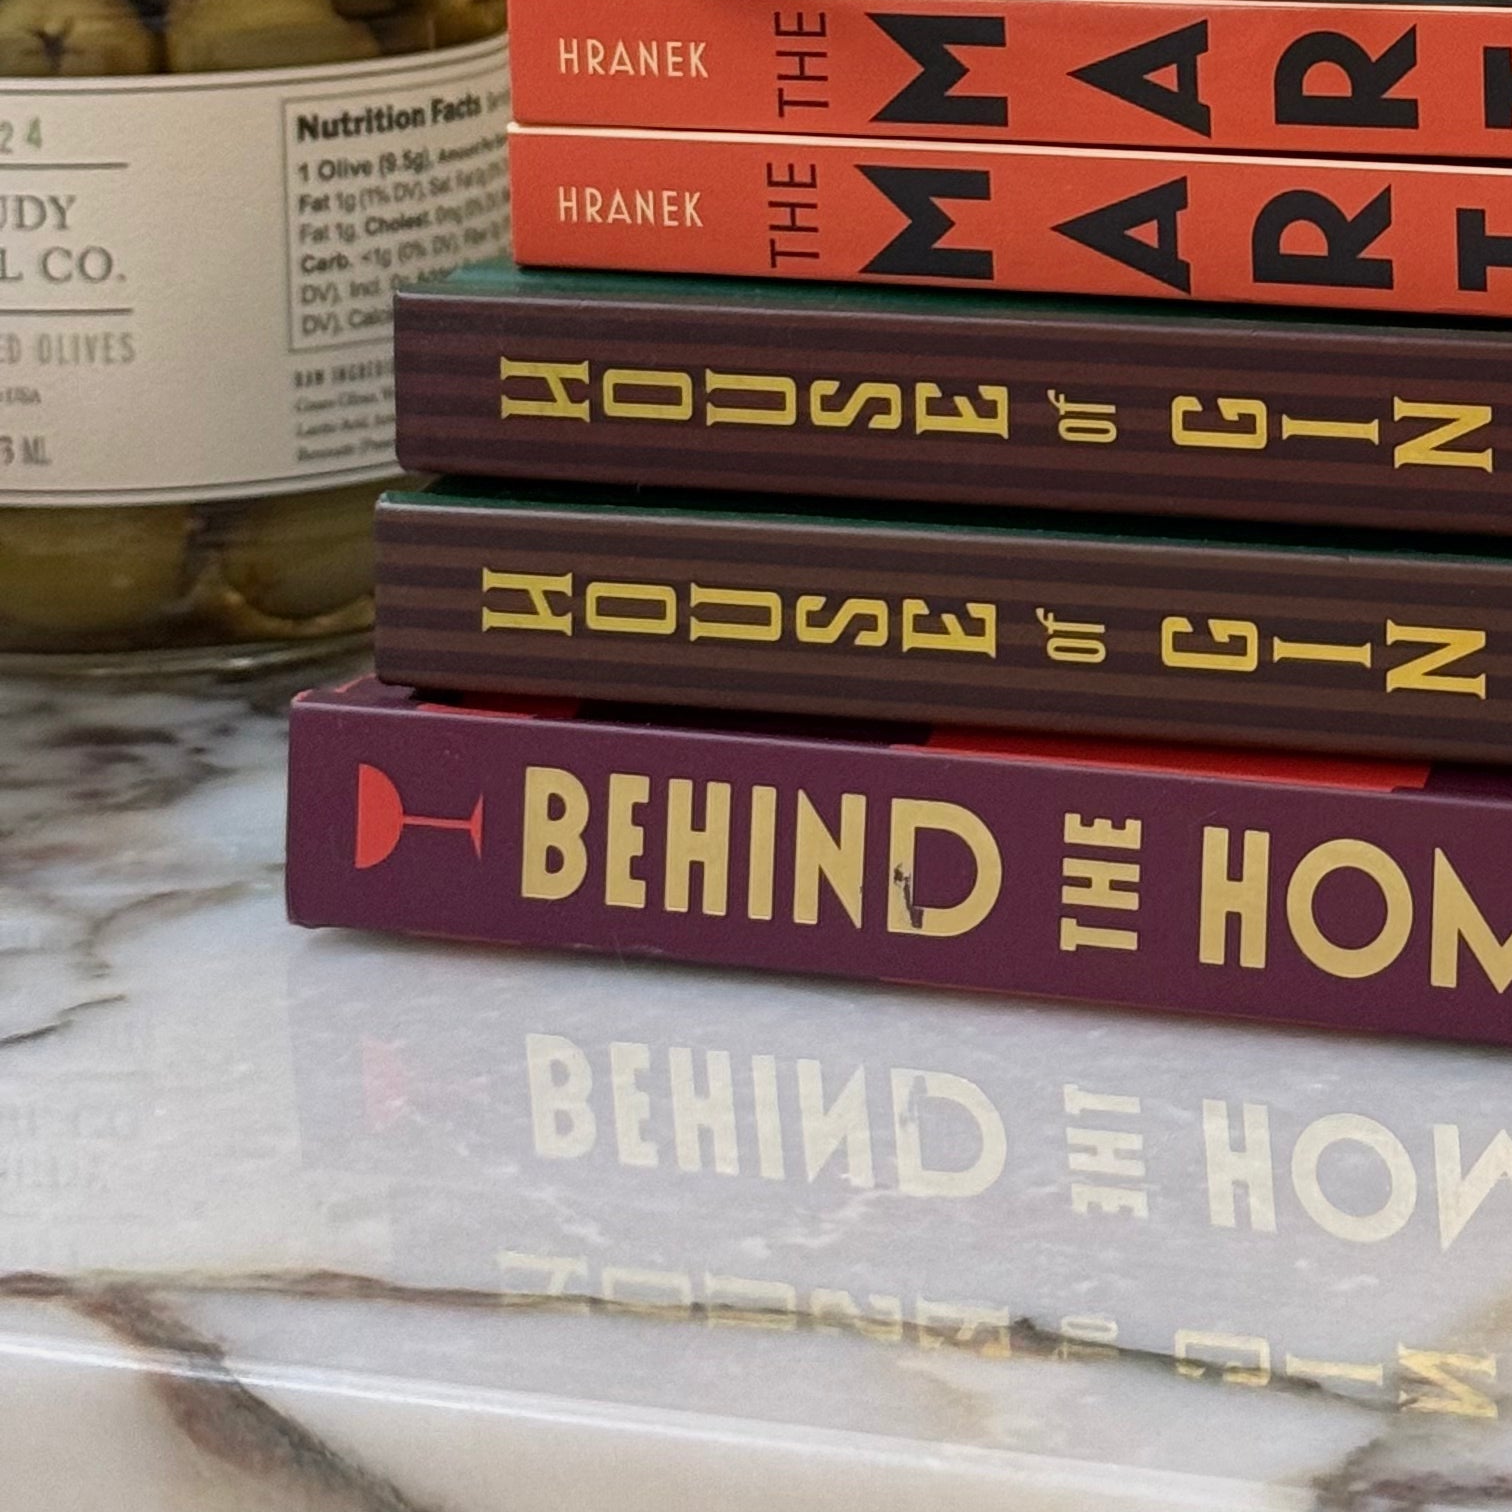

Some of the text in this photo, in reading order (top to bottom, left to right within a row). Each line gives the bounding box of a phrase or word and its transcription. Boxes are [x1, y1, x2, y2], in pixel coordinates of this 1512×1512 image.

[558, 37, 709, 79] HRANEK
[774, 11, 829, 118] THE
[297, 104, 426, 141] Nutrition
[317, 158, 374, 182] Olive
[557, 185, 704, 228] HRANEK
[766, 162, 820, 269] THE
[40, 245, 127, 284] CO.
[37, 331, 137, 366] OLIVES
[500, 355, 1493, 473] HOUSE of GIN
[482, 566, 1487, 700] HOUSE of GIN
[521, 765, 1003, 937] BEHIND
[1060, 812, 1142, 952] THE
